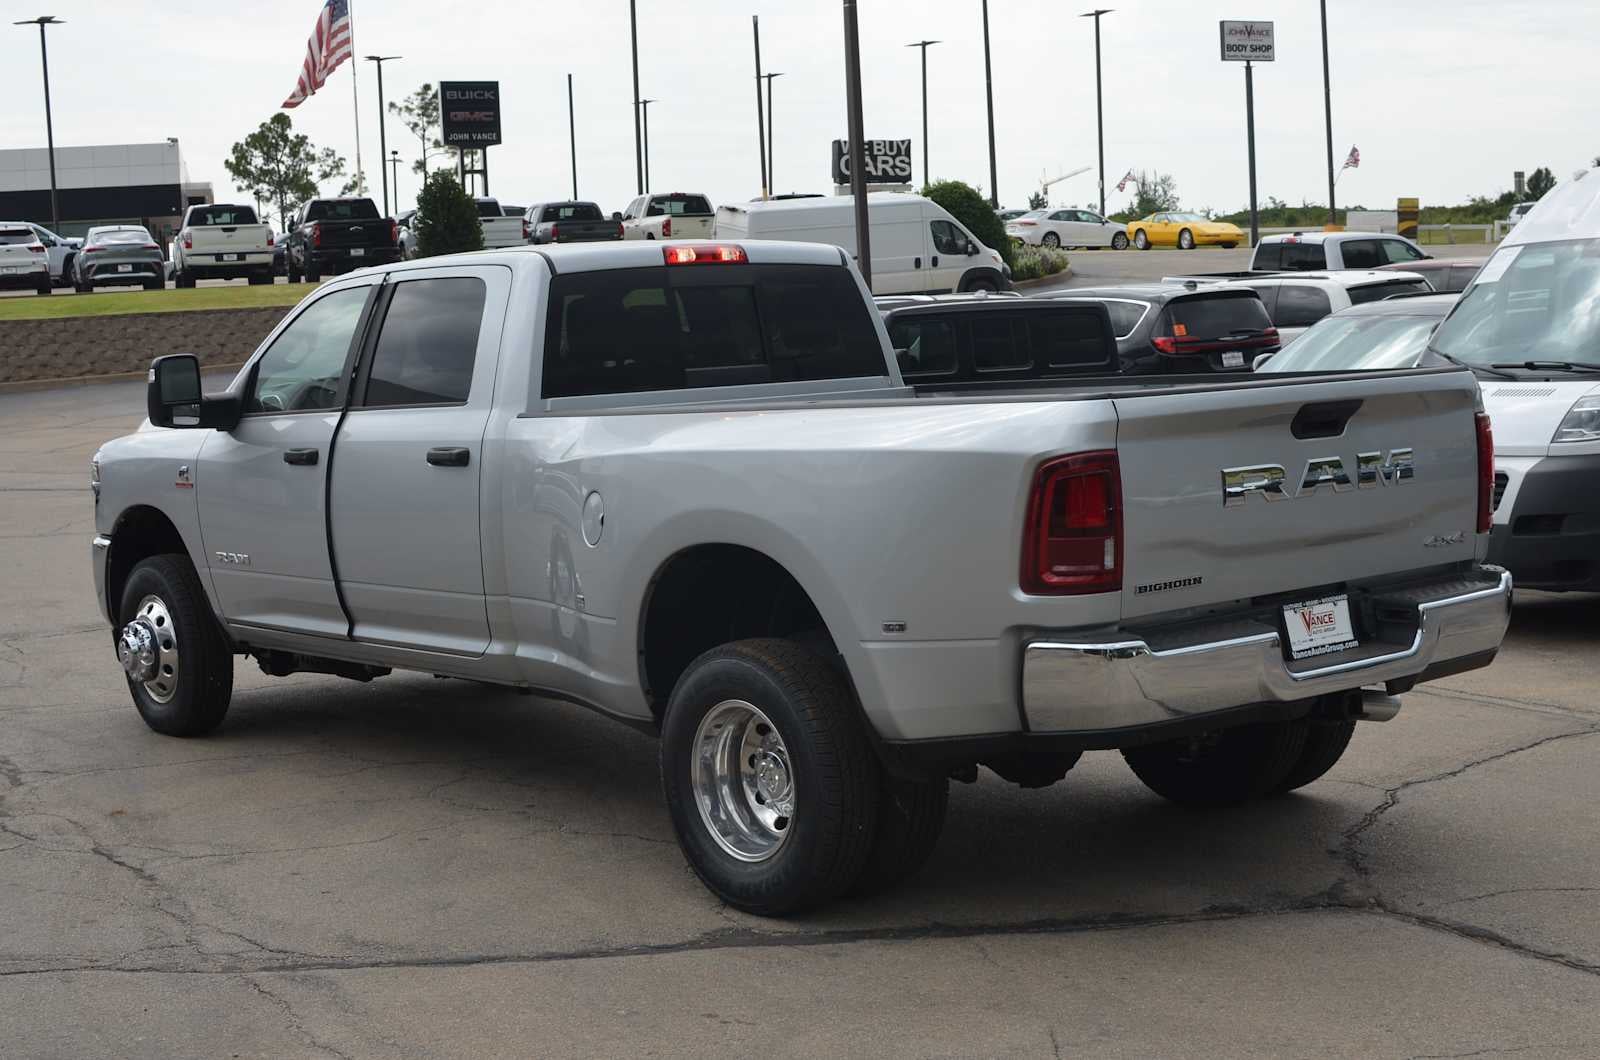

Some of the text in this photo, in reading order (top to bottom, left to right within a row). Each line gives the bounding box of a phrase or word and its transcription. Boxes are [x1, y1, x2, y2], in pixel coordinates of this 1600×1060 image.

[1226, 43, 1272, 54] BODY SHOP
[446, 90, 496, 100] BUICK
[449, 111, 494, 121] GMC
[448, 132, 496, 141] JOHN VANCE
[873, 140, 909, 156] BUY
[1221, 447, 1415, 508] RAM
[1135, 576, 1203, 594] BIGHORN
[1300, 608, 1335, 637] VANCE
[1292, 640, 1359, 660] VanceAutoGroup.com
